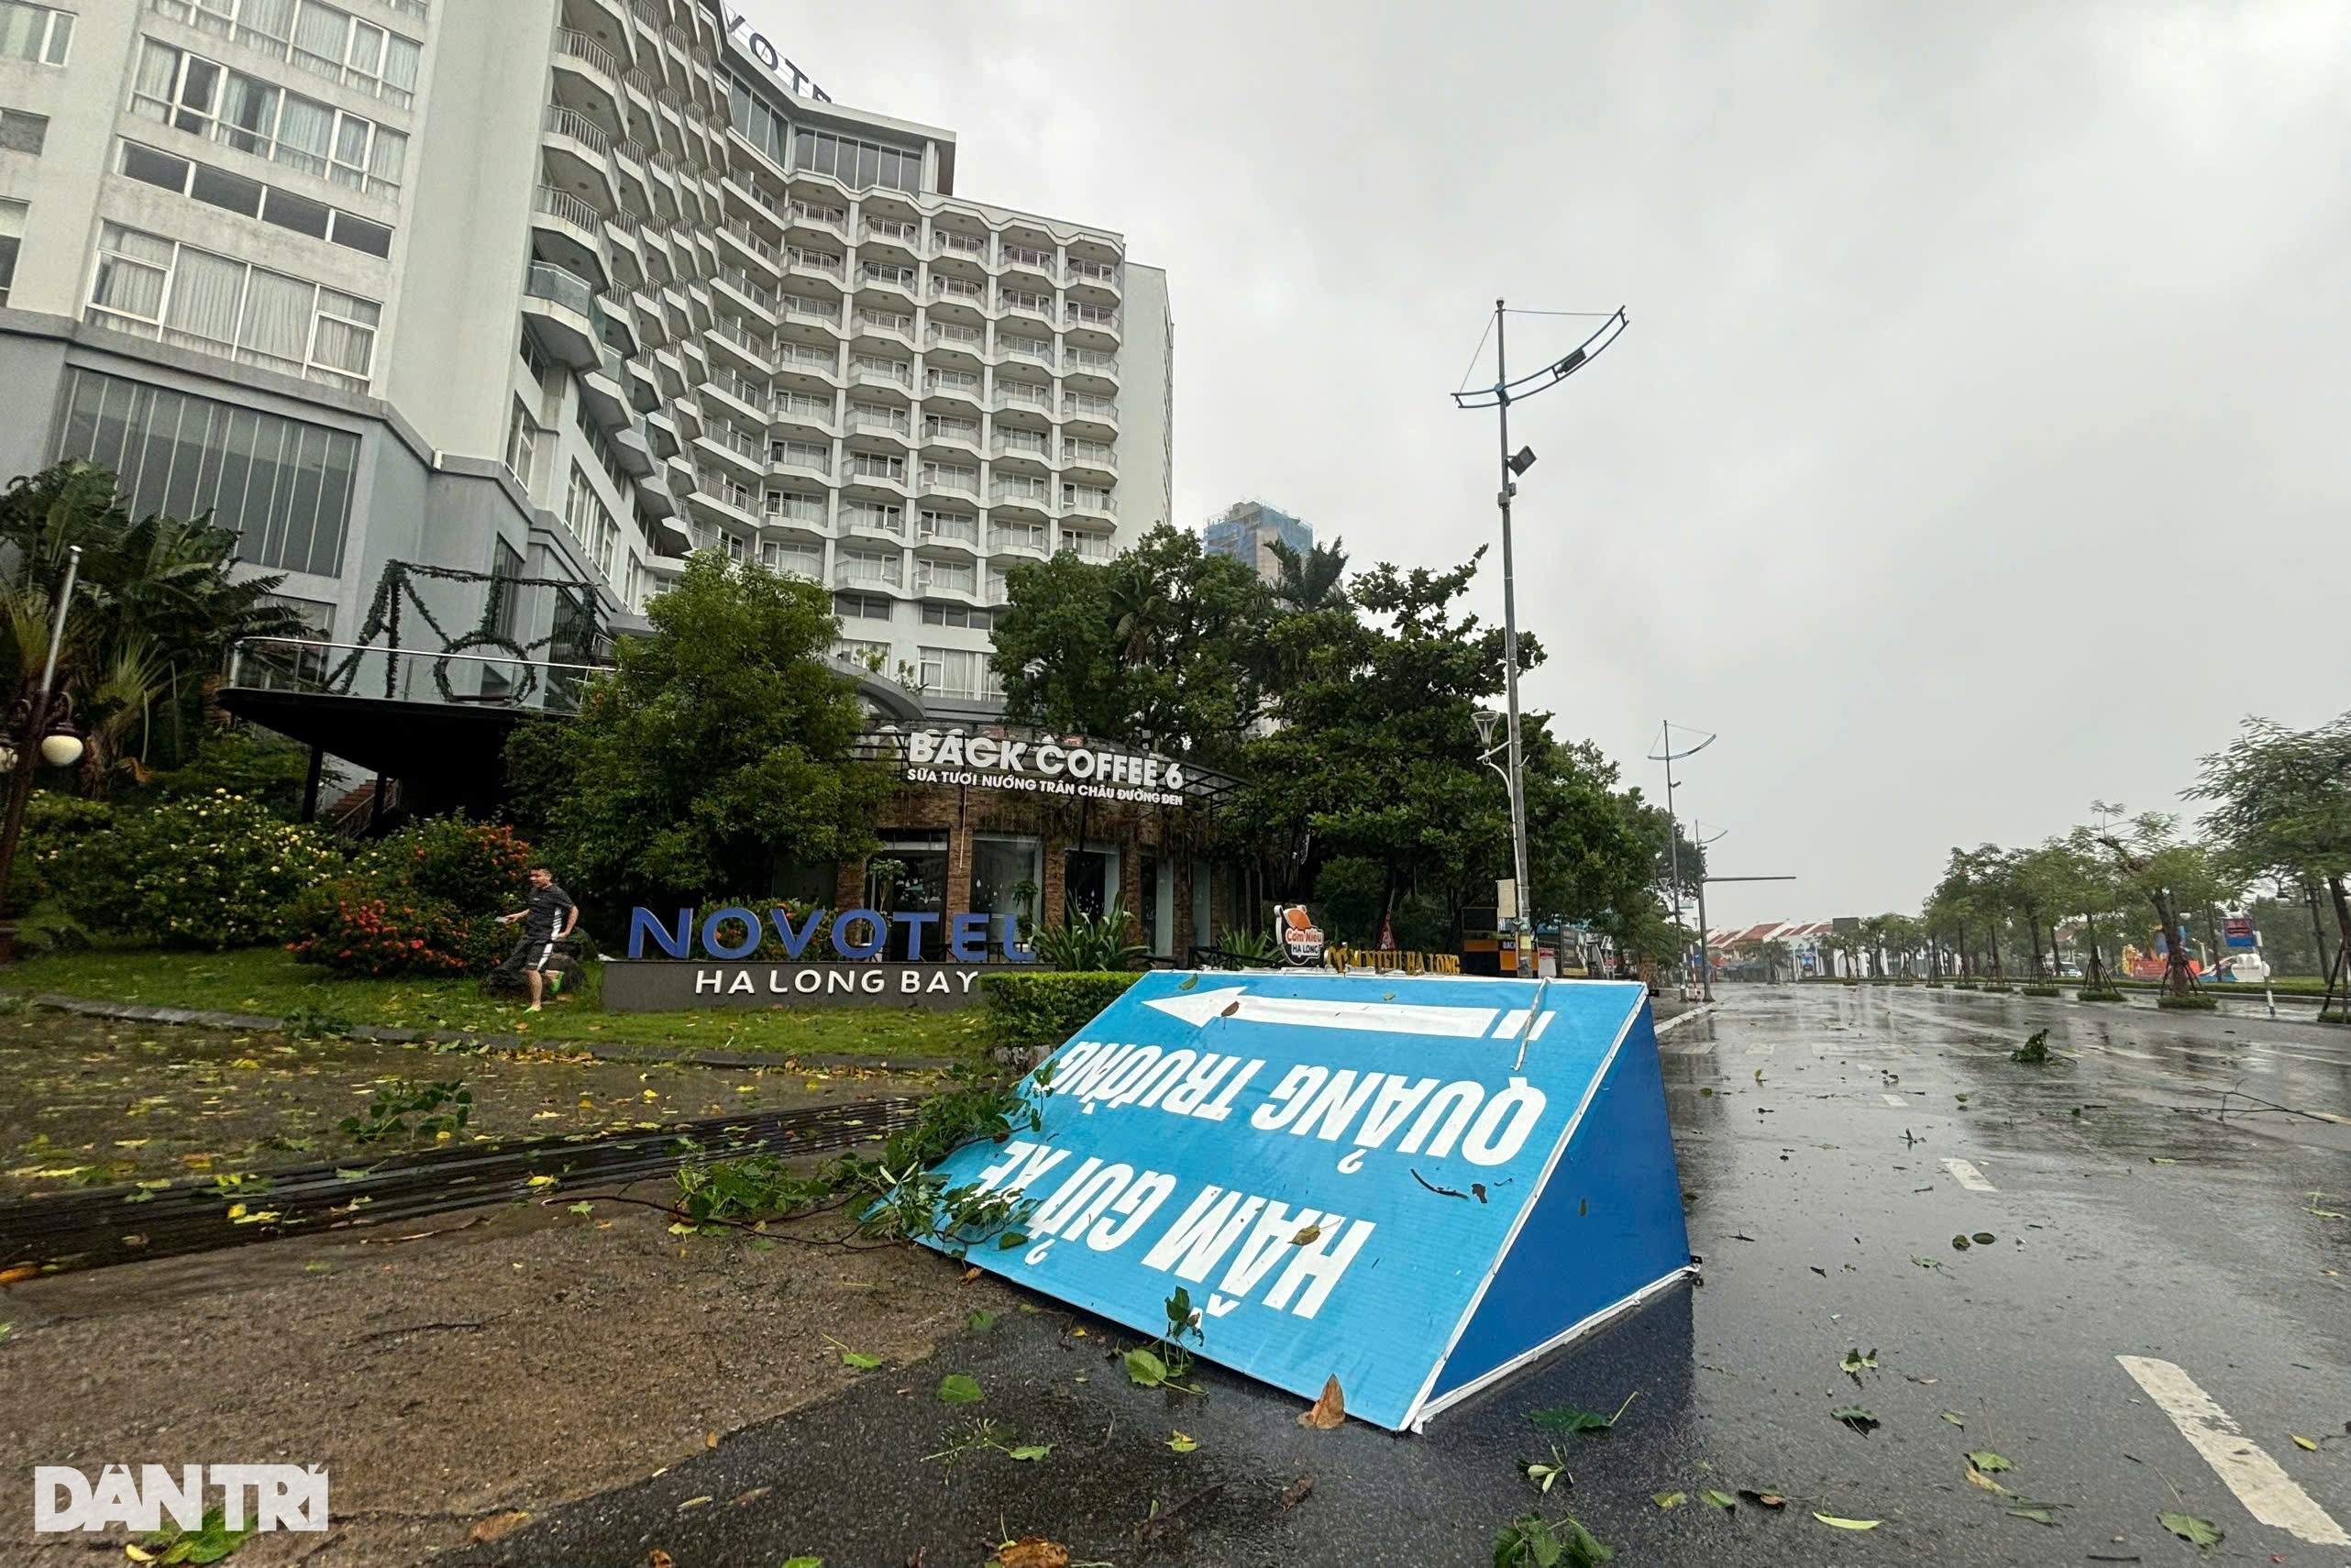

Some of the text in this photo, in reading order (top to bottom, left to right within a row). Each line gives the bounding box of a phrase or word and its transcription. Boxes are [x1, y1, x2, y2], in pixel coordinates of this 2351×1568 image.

[907, 767, 1184, 807] SỮA TƯƠI NƯỚNG TRÂN CHÂU ĐƯỜNG ĐEN
[1036, 745, 1158, 788] COFFEE
[1164, 764, 1184, 790] 6
[627, 906, 1037, 962] NOVOTEL
[1302, 944, 1319, 955] LONG
[694, 969, 979, 995] HA LONG BAY
[1033, 1041, 1547, 1175] QUẢNG TRƯỜNG
[1024, 1156, 1176, 1265] GỬI
[1141, 1184, 1376, 1329] HẦM
